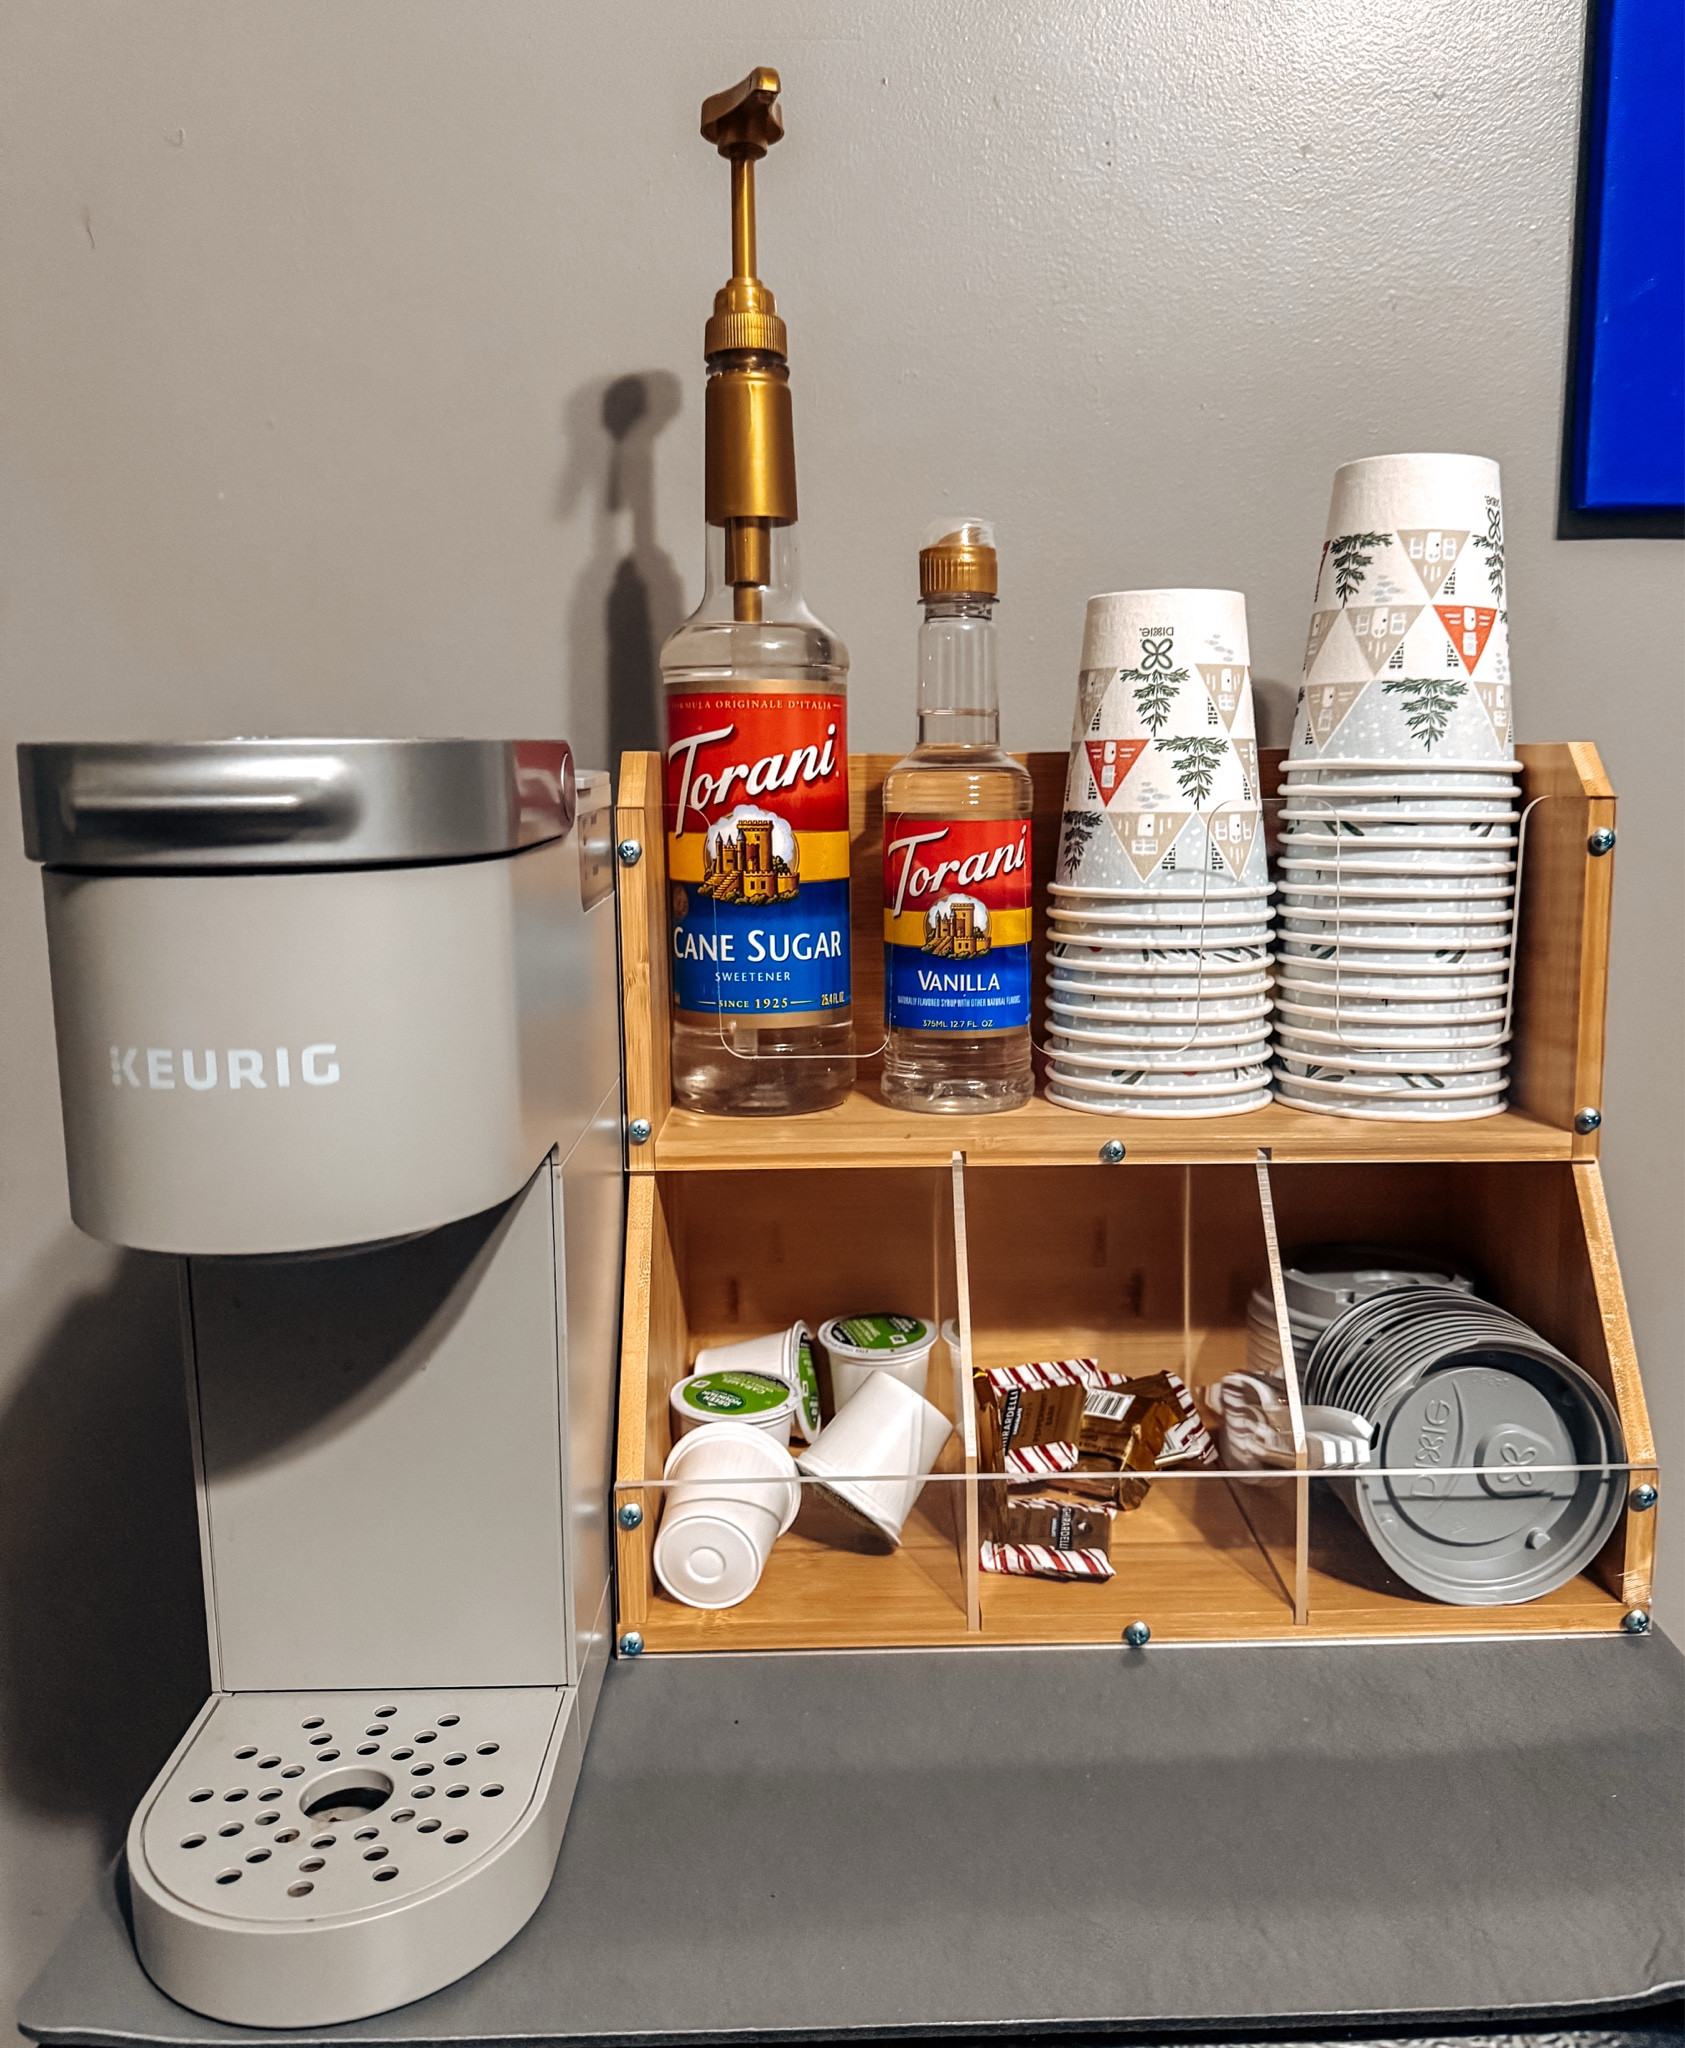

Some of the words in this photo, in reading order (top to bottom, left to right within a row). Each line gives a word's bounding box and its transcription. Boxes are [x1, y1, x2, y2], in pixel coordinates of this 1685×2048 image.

[671, 701, 711, 709] ORMULA
[715, 700, 783, 709] ORIGINALE
[788, 700, 831, 710] D'ITALIA
[668, 723, 836, 839] Torani
[888, 825, 1027, 919] Torani
[674, 926, 735, 962] CANE
[747, 929, 842, 962] SUGAR
[714, 972, 791, 982] SWEETENER
[918, 970, 1000, 991] VANILLA
[718, 1000, 749, 1009] SINCE
[755, 997, 788, 1009] 1925
[922, 1019, 947, 1028] 375ML
[109, 1043, 341, 1091] KEURIG
[1001, 1390, 1018, 1452] HIRARDELLI
[1059, 1506, 1072, 1550] GHIRARDELLI
